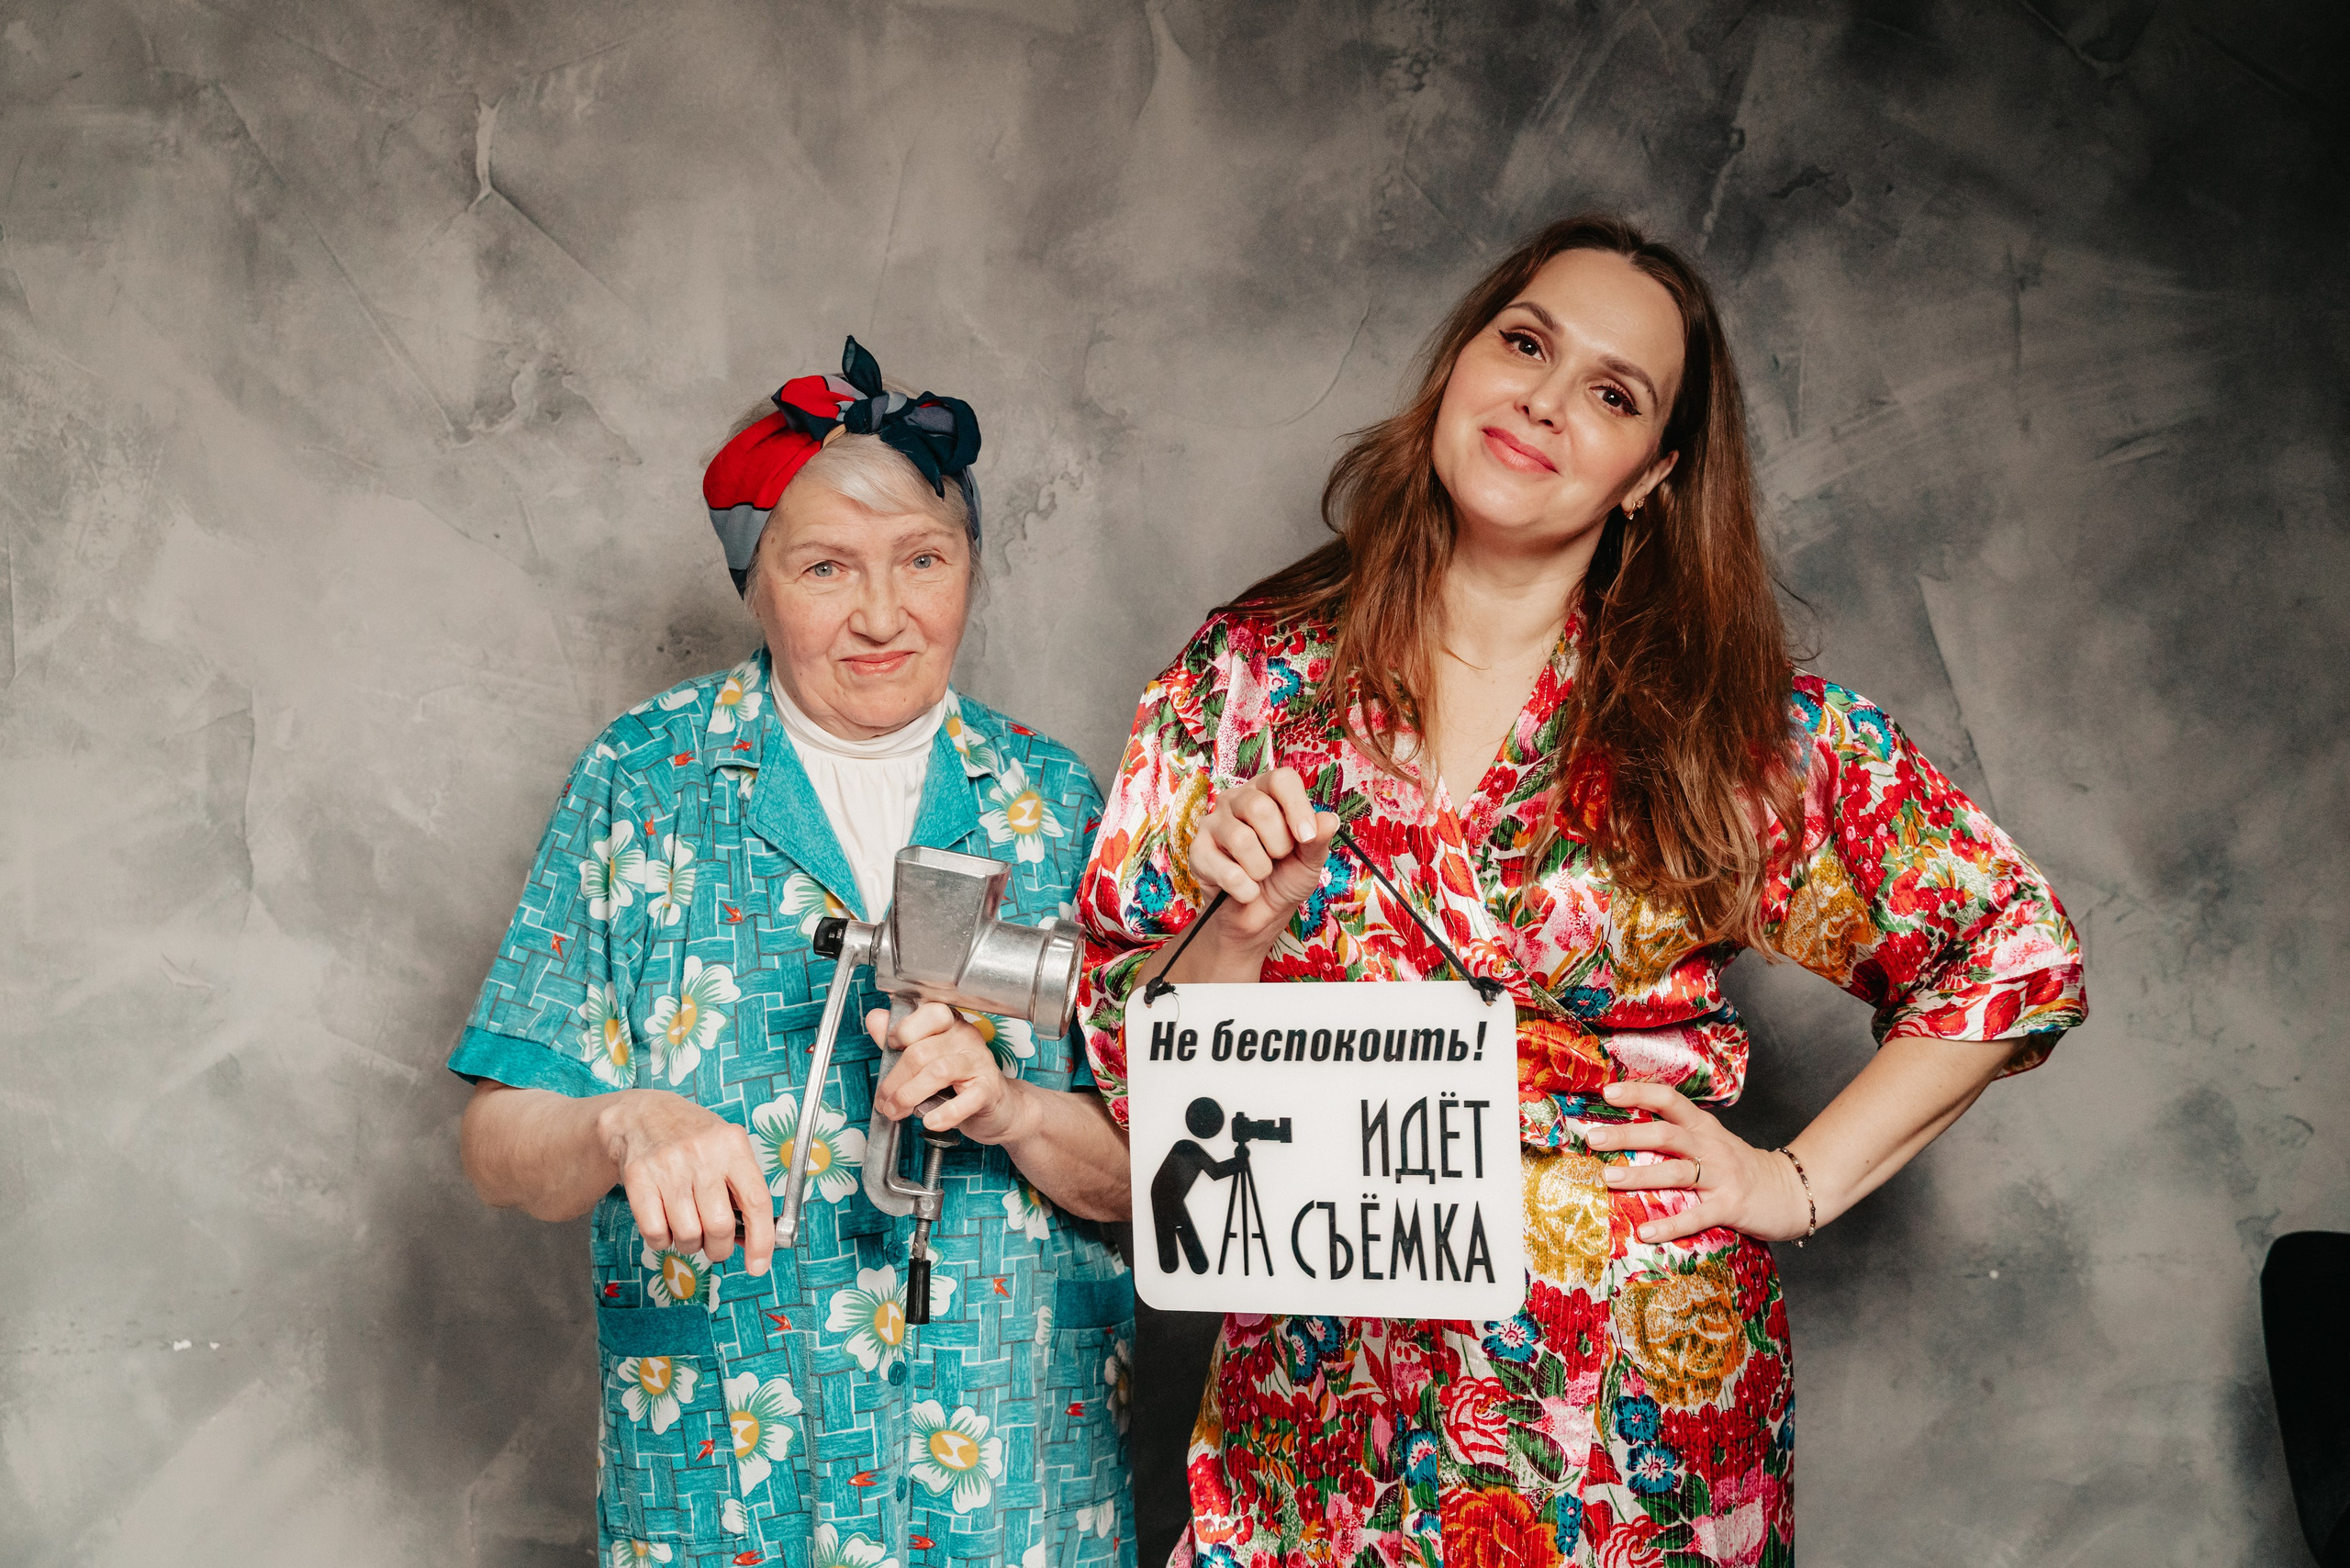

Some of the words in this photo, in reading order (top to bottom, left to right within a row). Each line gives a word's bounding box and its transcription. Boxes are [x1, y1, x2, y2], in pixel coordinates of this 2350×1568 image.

[1149, 1021, 1198, 1062] Не
[1211, 1018, 1487, 1062] беспокоить!
[1360, 1091, 1490, 1185] ИДЁТ
[1291, 1193, 1496, 1284] СЪЁМКА
